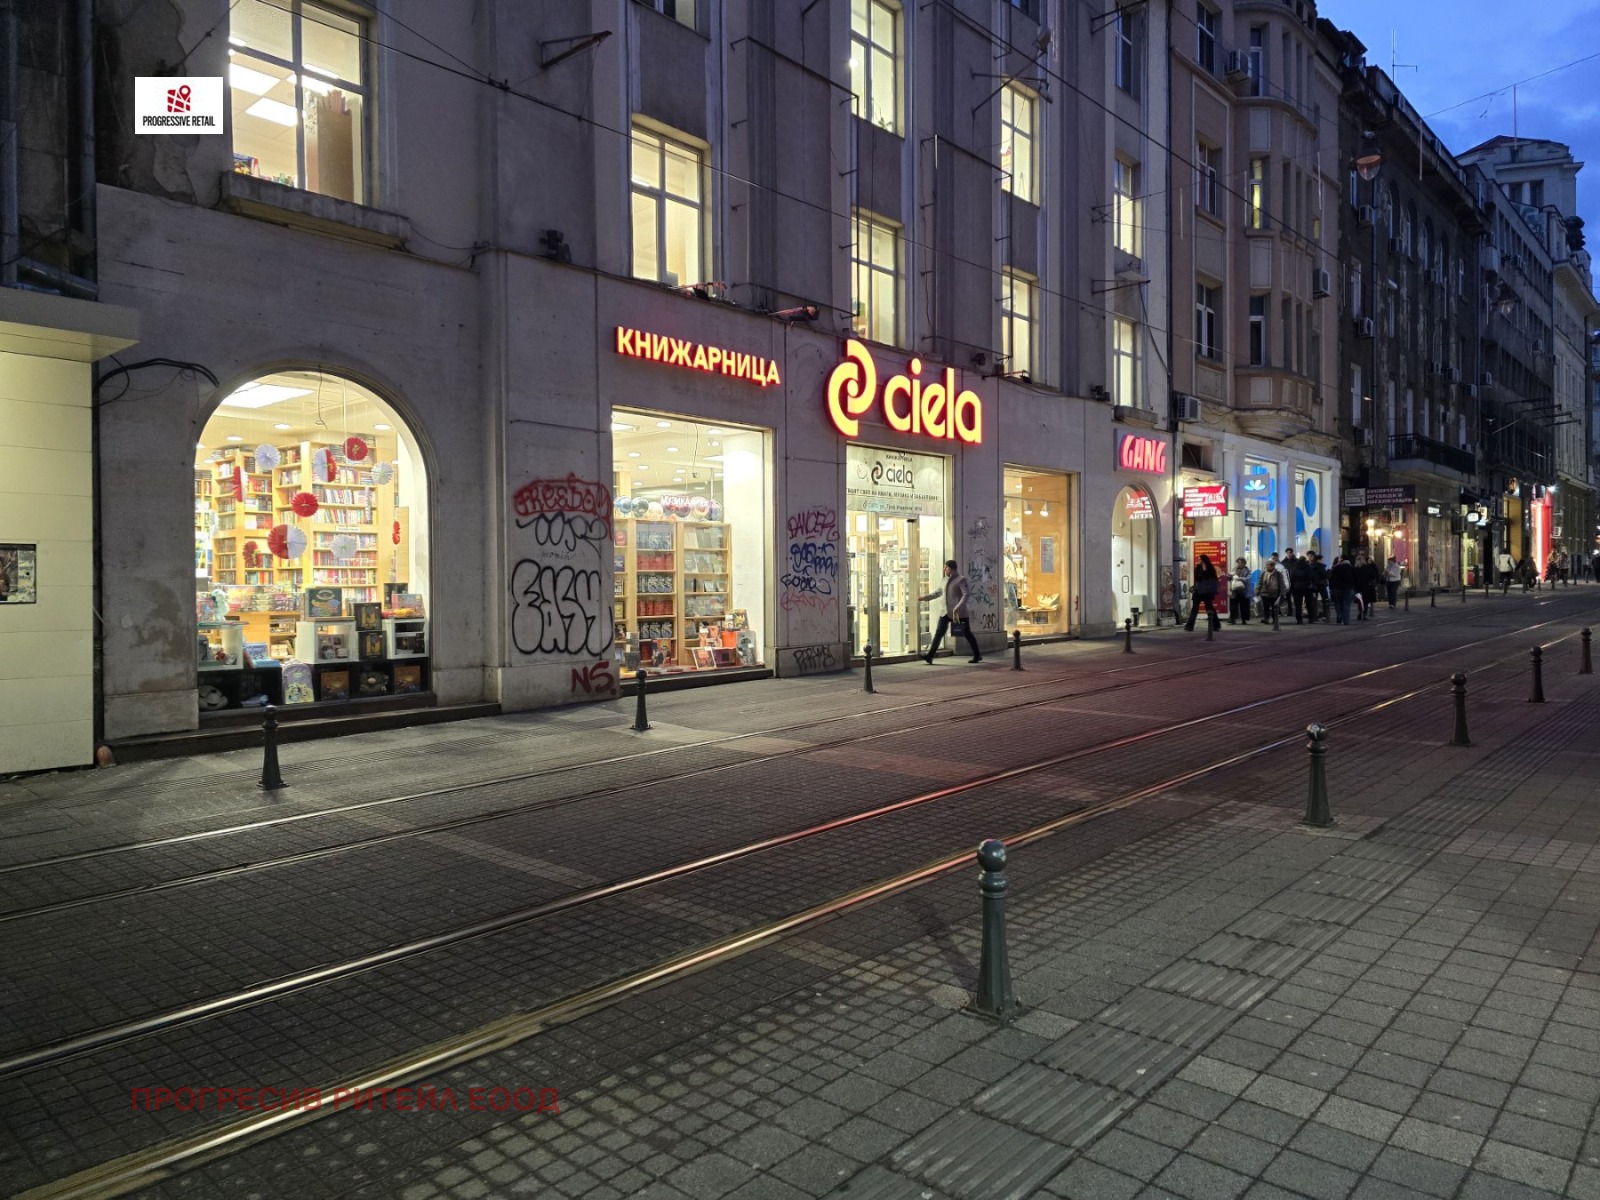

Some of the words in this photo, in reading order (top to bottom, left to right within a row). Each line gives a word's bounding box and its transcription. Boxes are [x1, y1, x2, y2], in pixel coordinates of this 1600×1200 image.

[615, 326, 781, 387] КНИЖАРНИЦА
[883, 358, 983, 444] ciela
[886, 462, 913, 484] ciela
[1121, 434, 1166, 473] GANG
